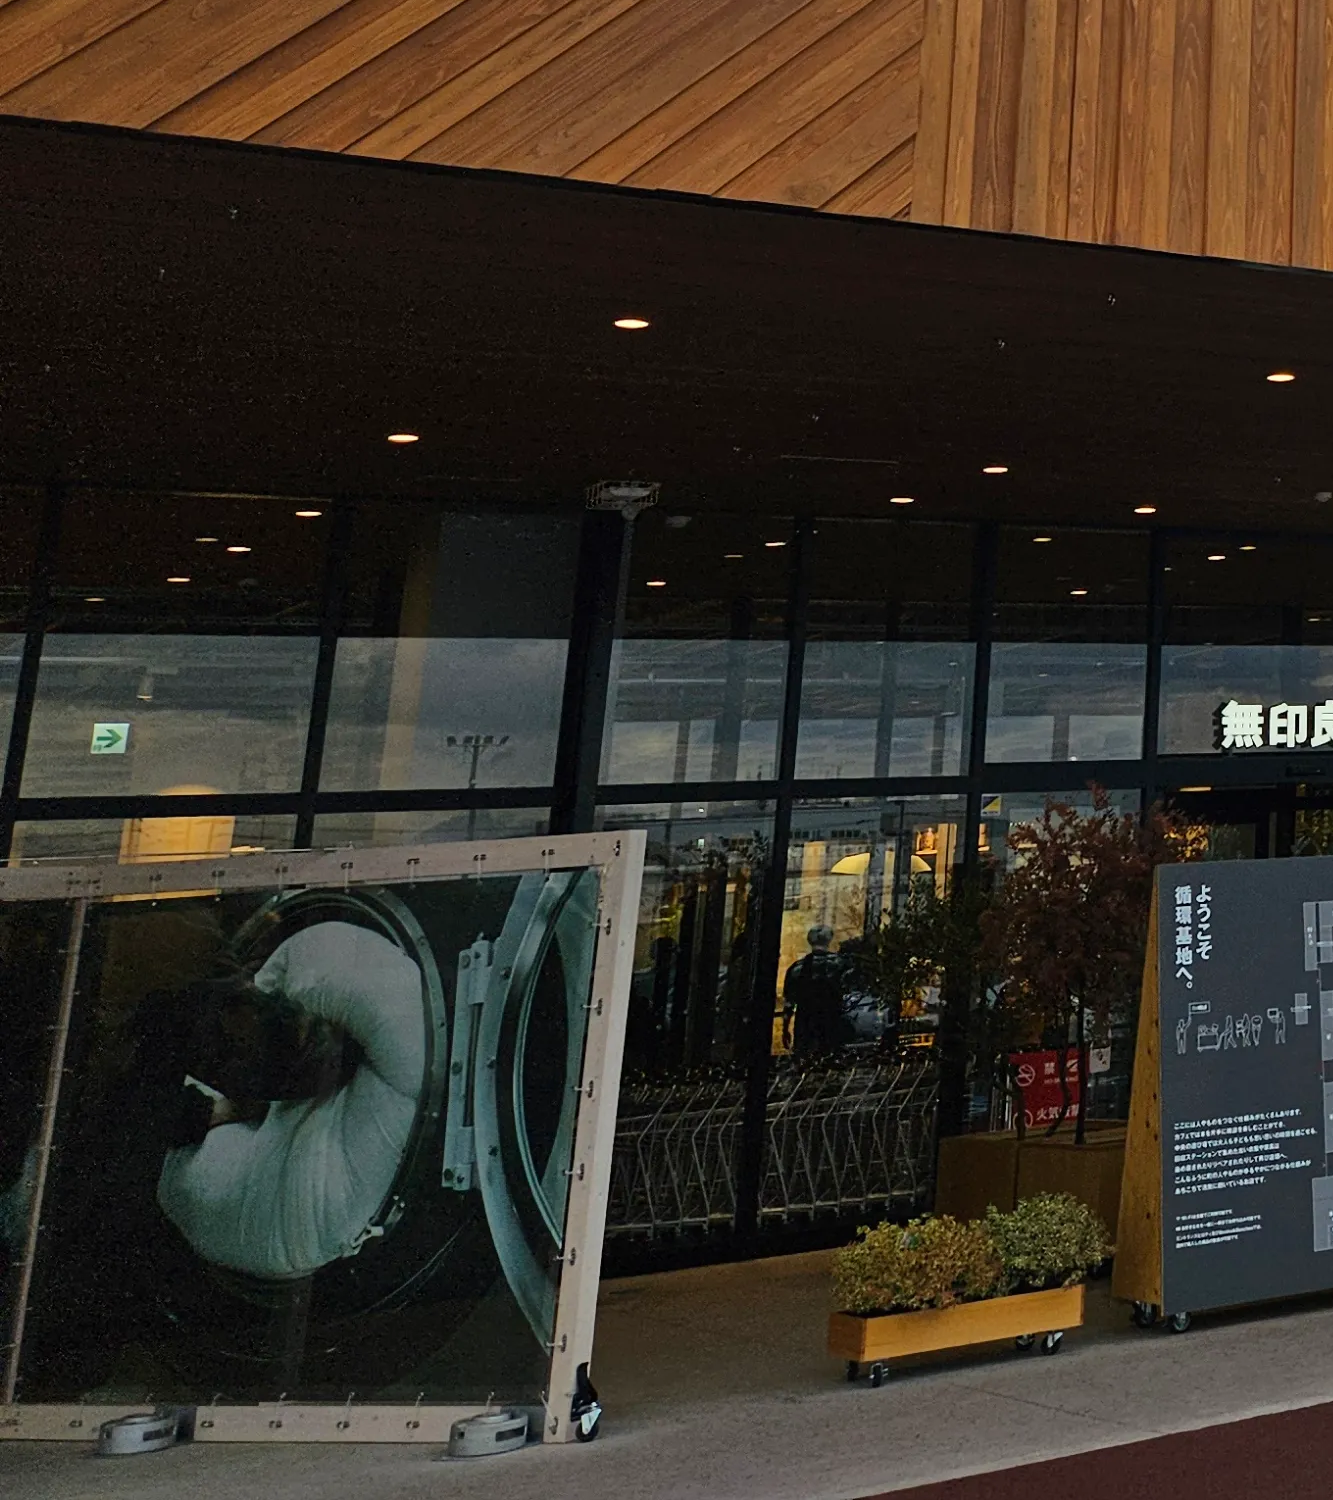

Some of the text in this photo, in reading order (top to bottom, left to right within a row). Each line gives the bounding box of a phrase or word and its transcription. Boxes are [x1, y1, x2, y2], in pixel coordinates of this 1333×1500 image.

[1174, 885, 1194, 989] 循環基地へ。
[1195, 885, 1213, 960] ようこそ
